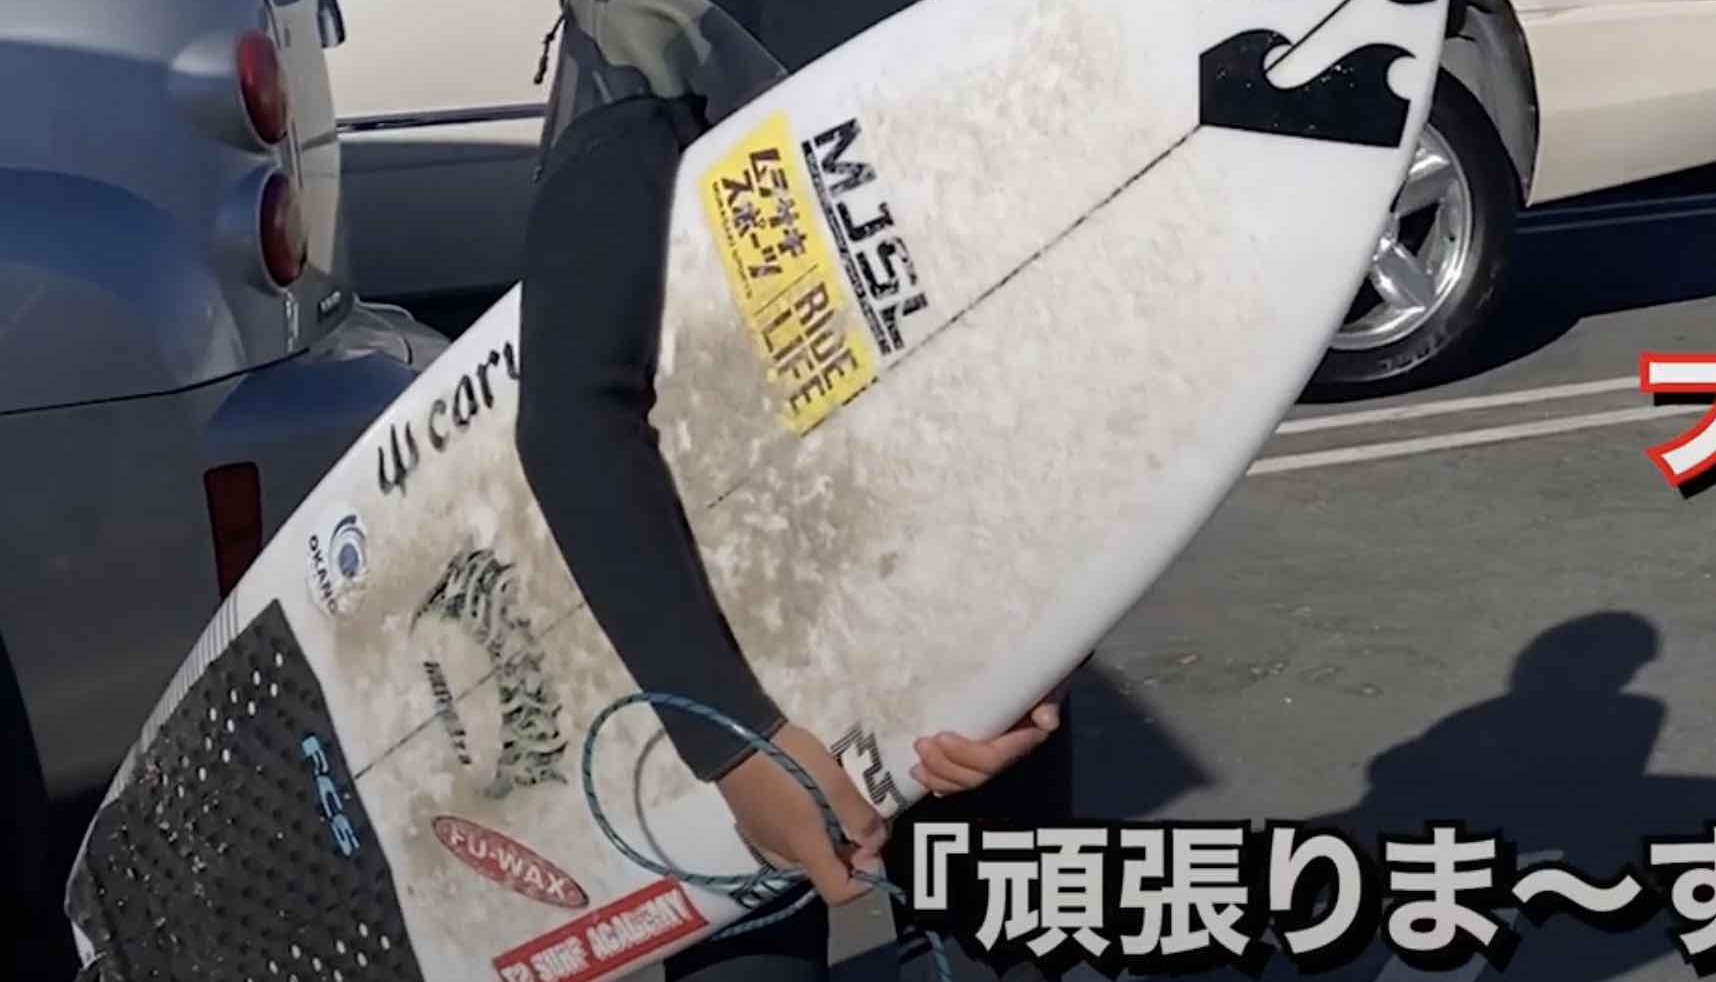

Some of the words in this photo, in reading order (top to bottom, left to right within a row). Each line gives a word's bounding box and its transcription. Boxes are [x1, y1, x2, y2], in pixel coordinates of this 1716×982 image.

[721, 169, 783, 279] スポーツ
[761, 308, 827, 412] LIFE
[793, 281, 858, 390] RIDE
[302, 735, 360, 856] FCS
[448, 823, 568, 899] FU-WAX
